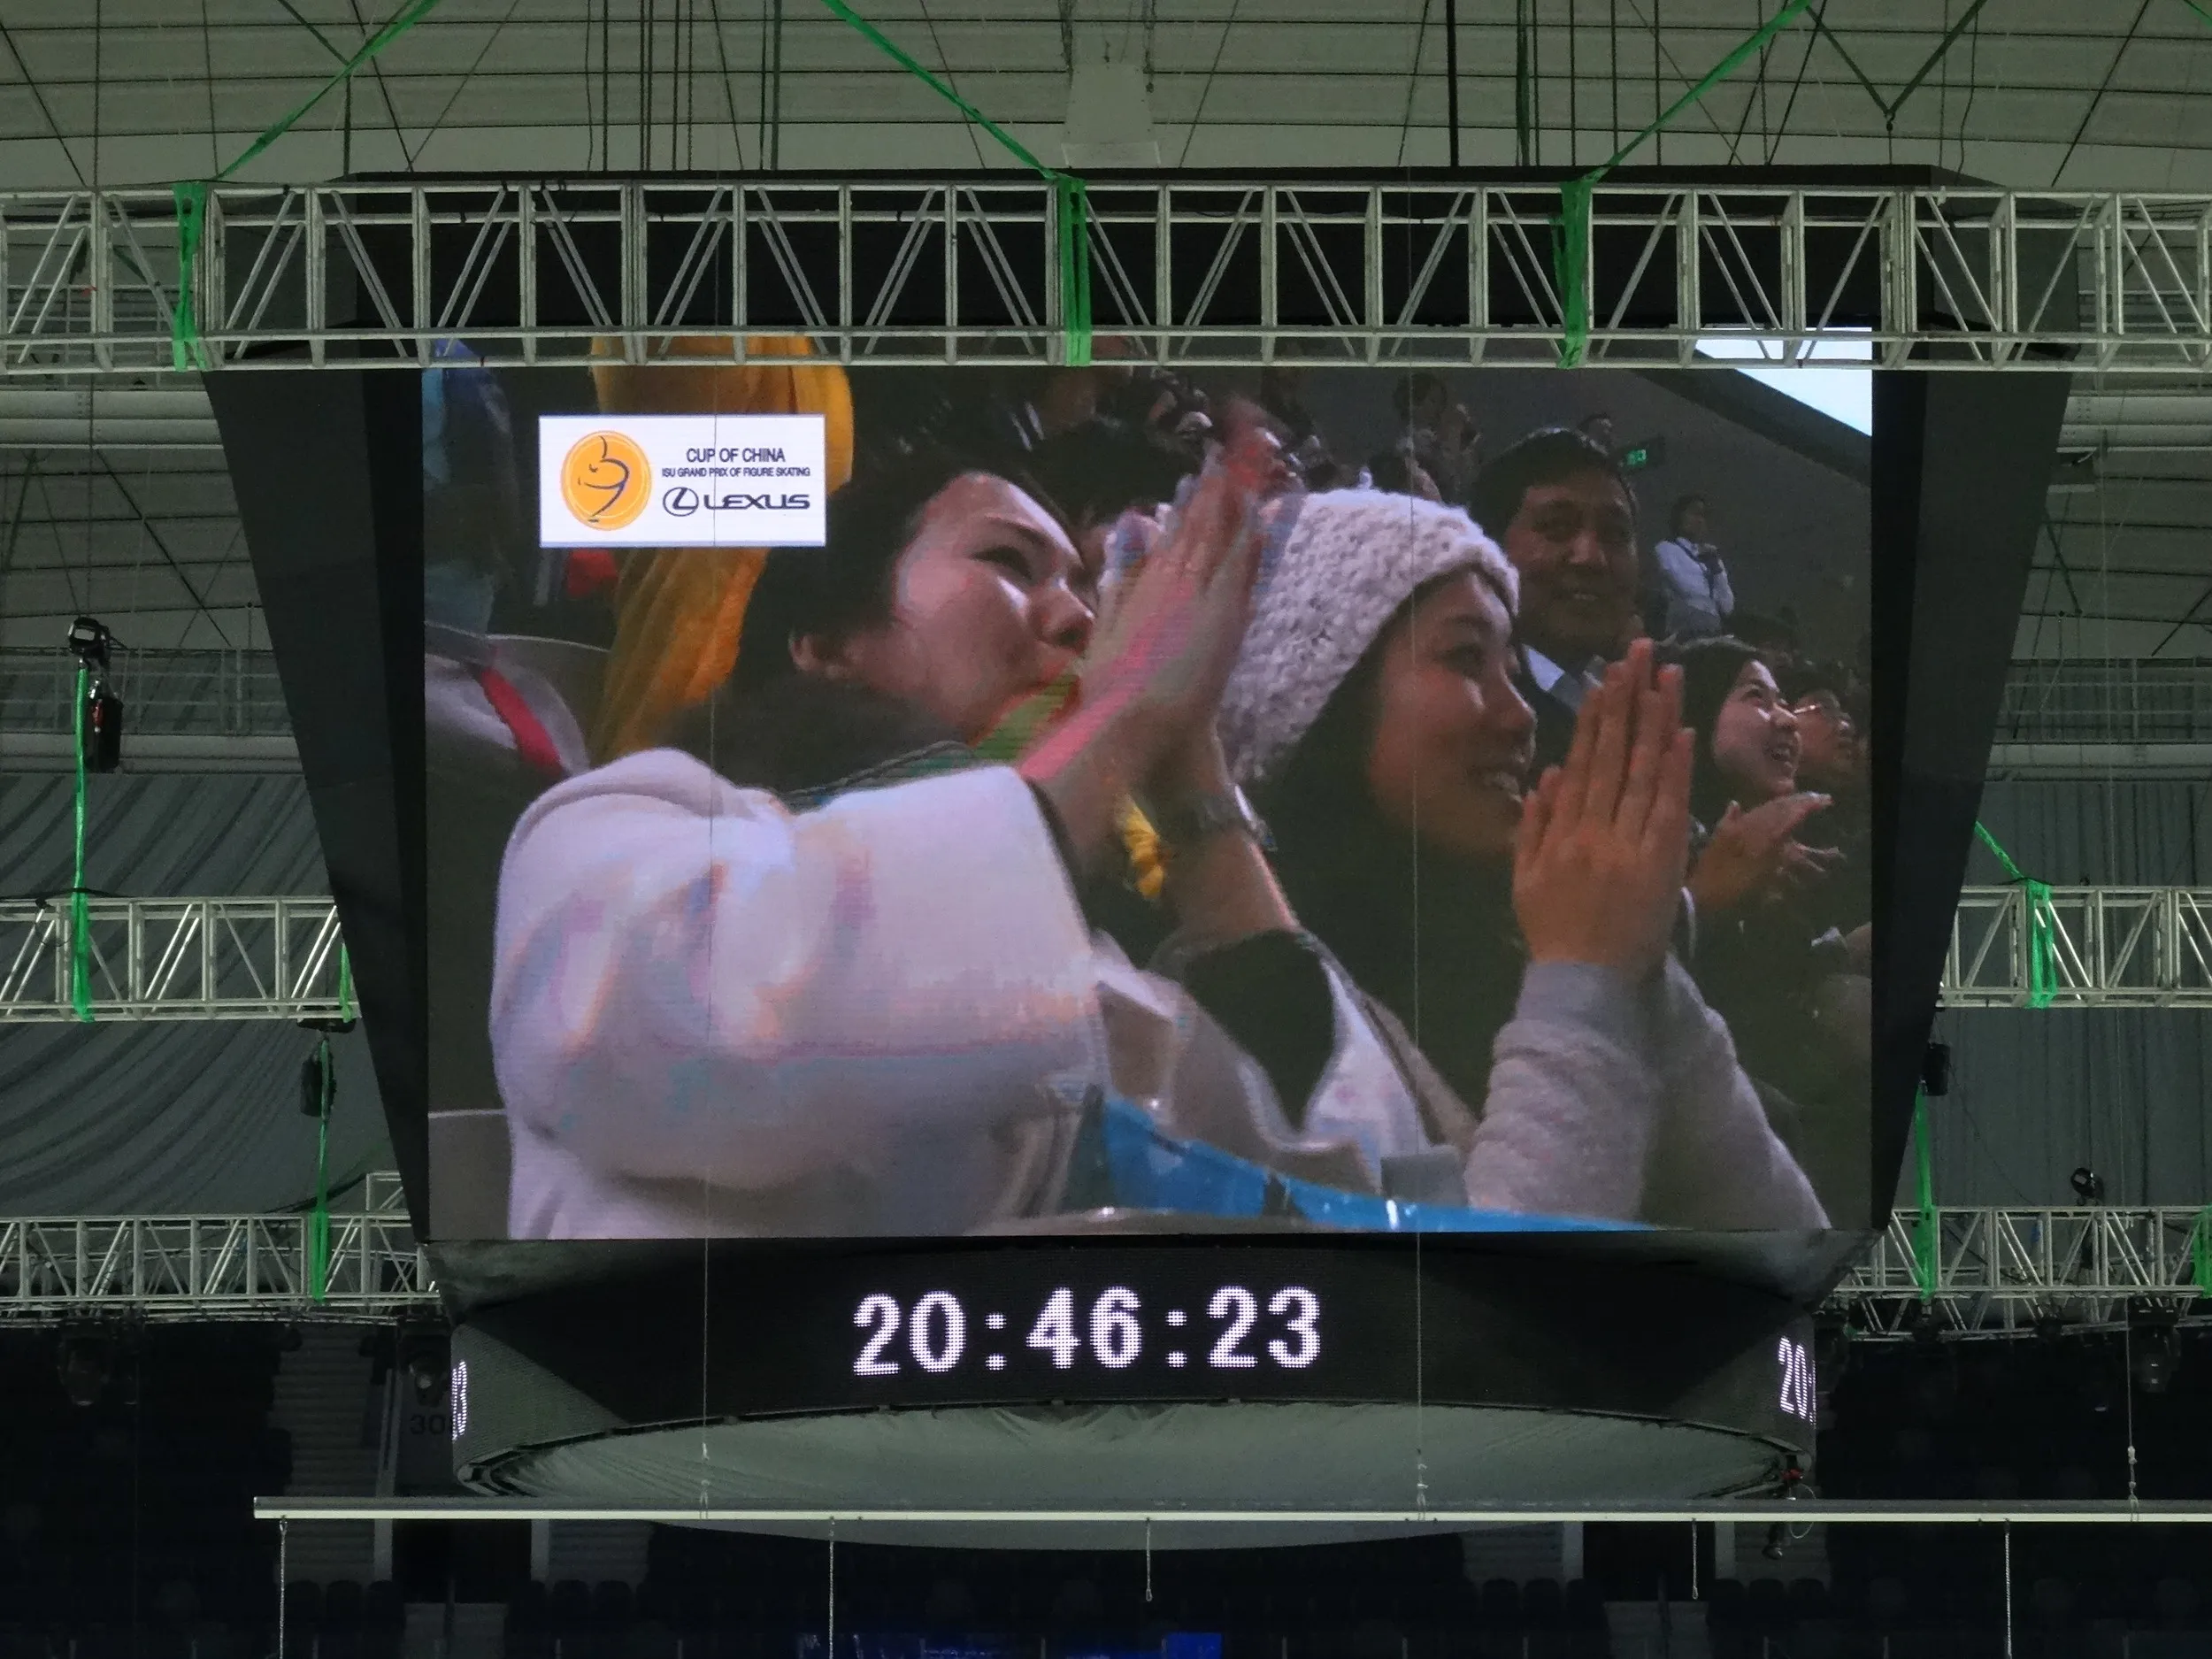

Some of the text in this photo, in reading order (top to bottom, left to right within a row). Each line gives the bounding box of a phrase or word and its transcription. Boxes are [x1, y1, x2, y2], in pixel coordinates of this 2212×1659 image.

[686, 448, 786, 463] CUP OF CHINA
[662, 467, 810, 477] ISU GRAND PRIX OF FIGURE SKATING
[703, 494, 810, 510] LEXUS
[853, 1285, 1322, 1376] 20:46:23
